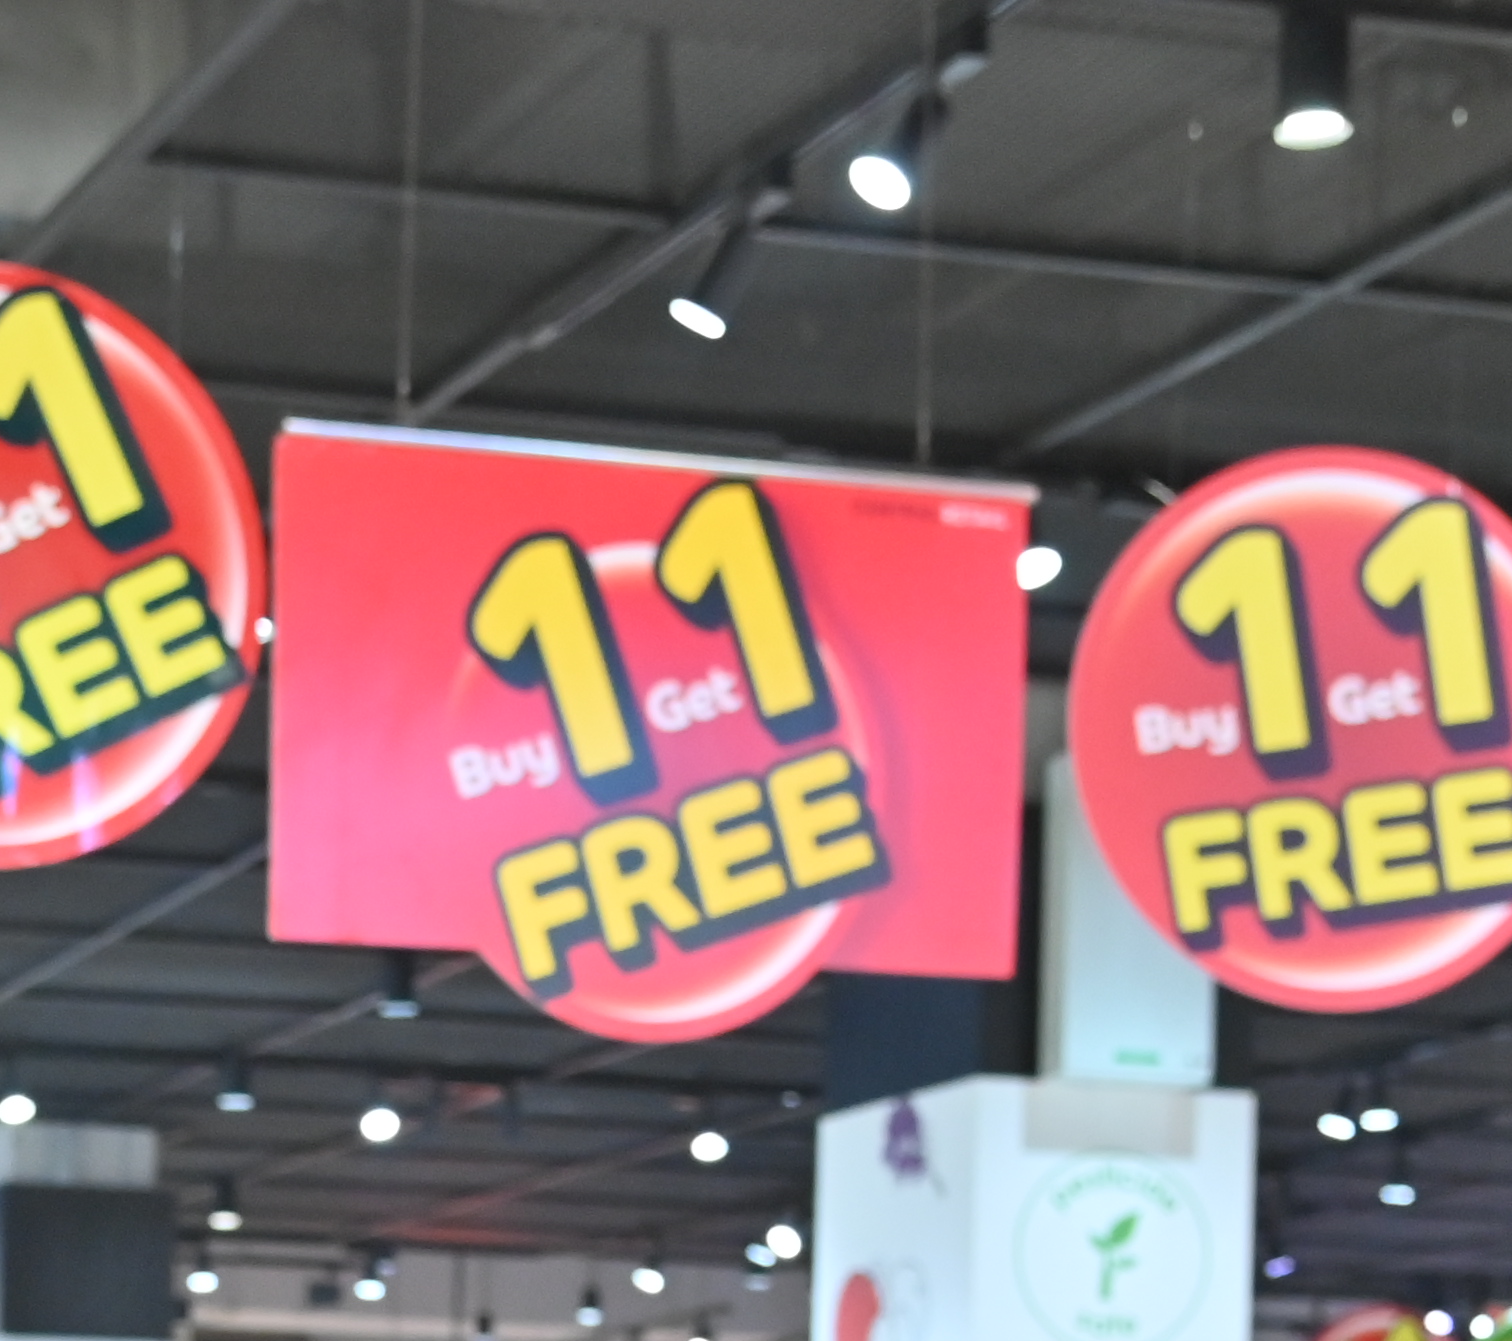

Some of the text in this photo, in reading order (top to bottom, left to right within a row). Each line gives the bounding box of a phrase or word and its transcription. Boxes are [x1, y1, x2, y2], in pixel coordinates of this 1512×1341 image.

[447, 479, 818, 800] Buy 1 Get 1
[1132, 498, 1495, 757] Buy 1 Get 1
[495, 747, 878, 984] FREE
